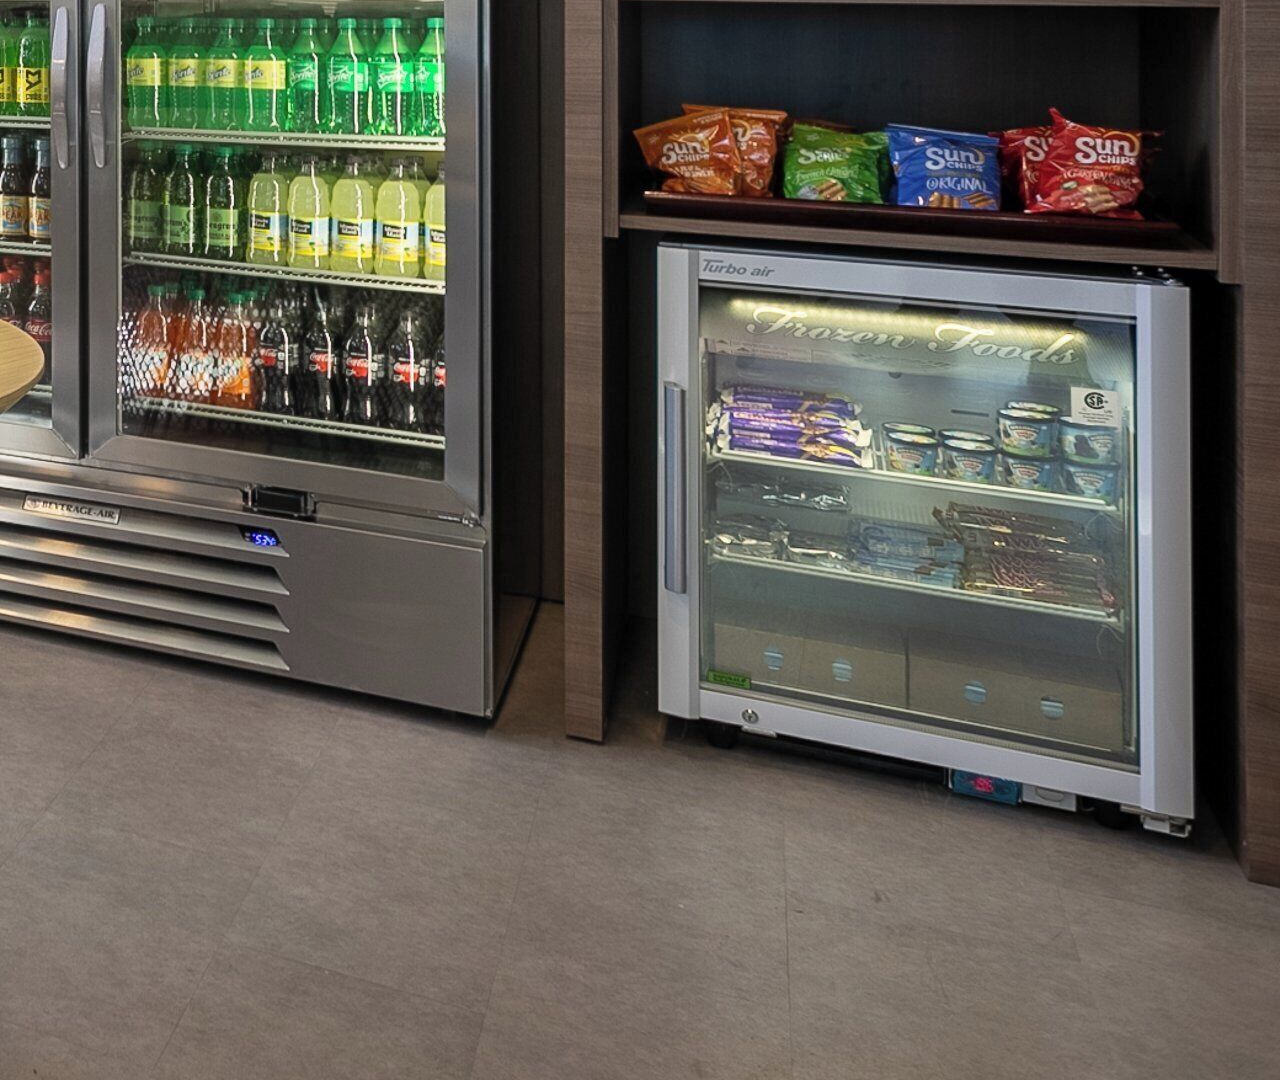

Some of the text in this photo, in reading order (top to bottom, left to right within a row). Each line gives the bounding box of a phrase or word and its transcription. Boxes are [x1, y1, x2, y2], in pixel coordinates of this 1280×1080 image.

[662, 142, 710, 164] Sun
[925, 147, 984, 171] Sun
[1074, 136, 1140, 164] Sun
[946, 162, 983, 172] CHIPS
[1098, 155, 1137, 166] CHIPS
[926, 176, 990, 193] ORIGINAL
[702, 259, 775, 278] Turbo air
[746, 305, 1079, 365] Frozen Foods
[42, 500, 115, 519] BEVERAGE-AIR
